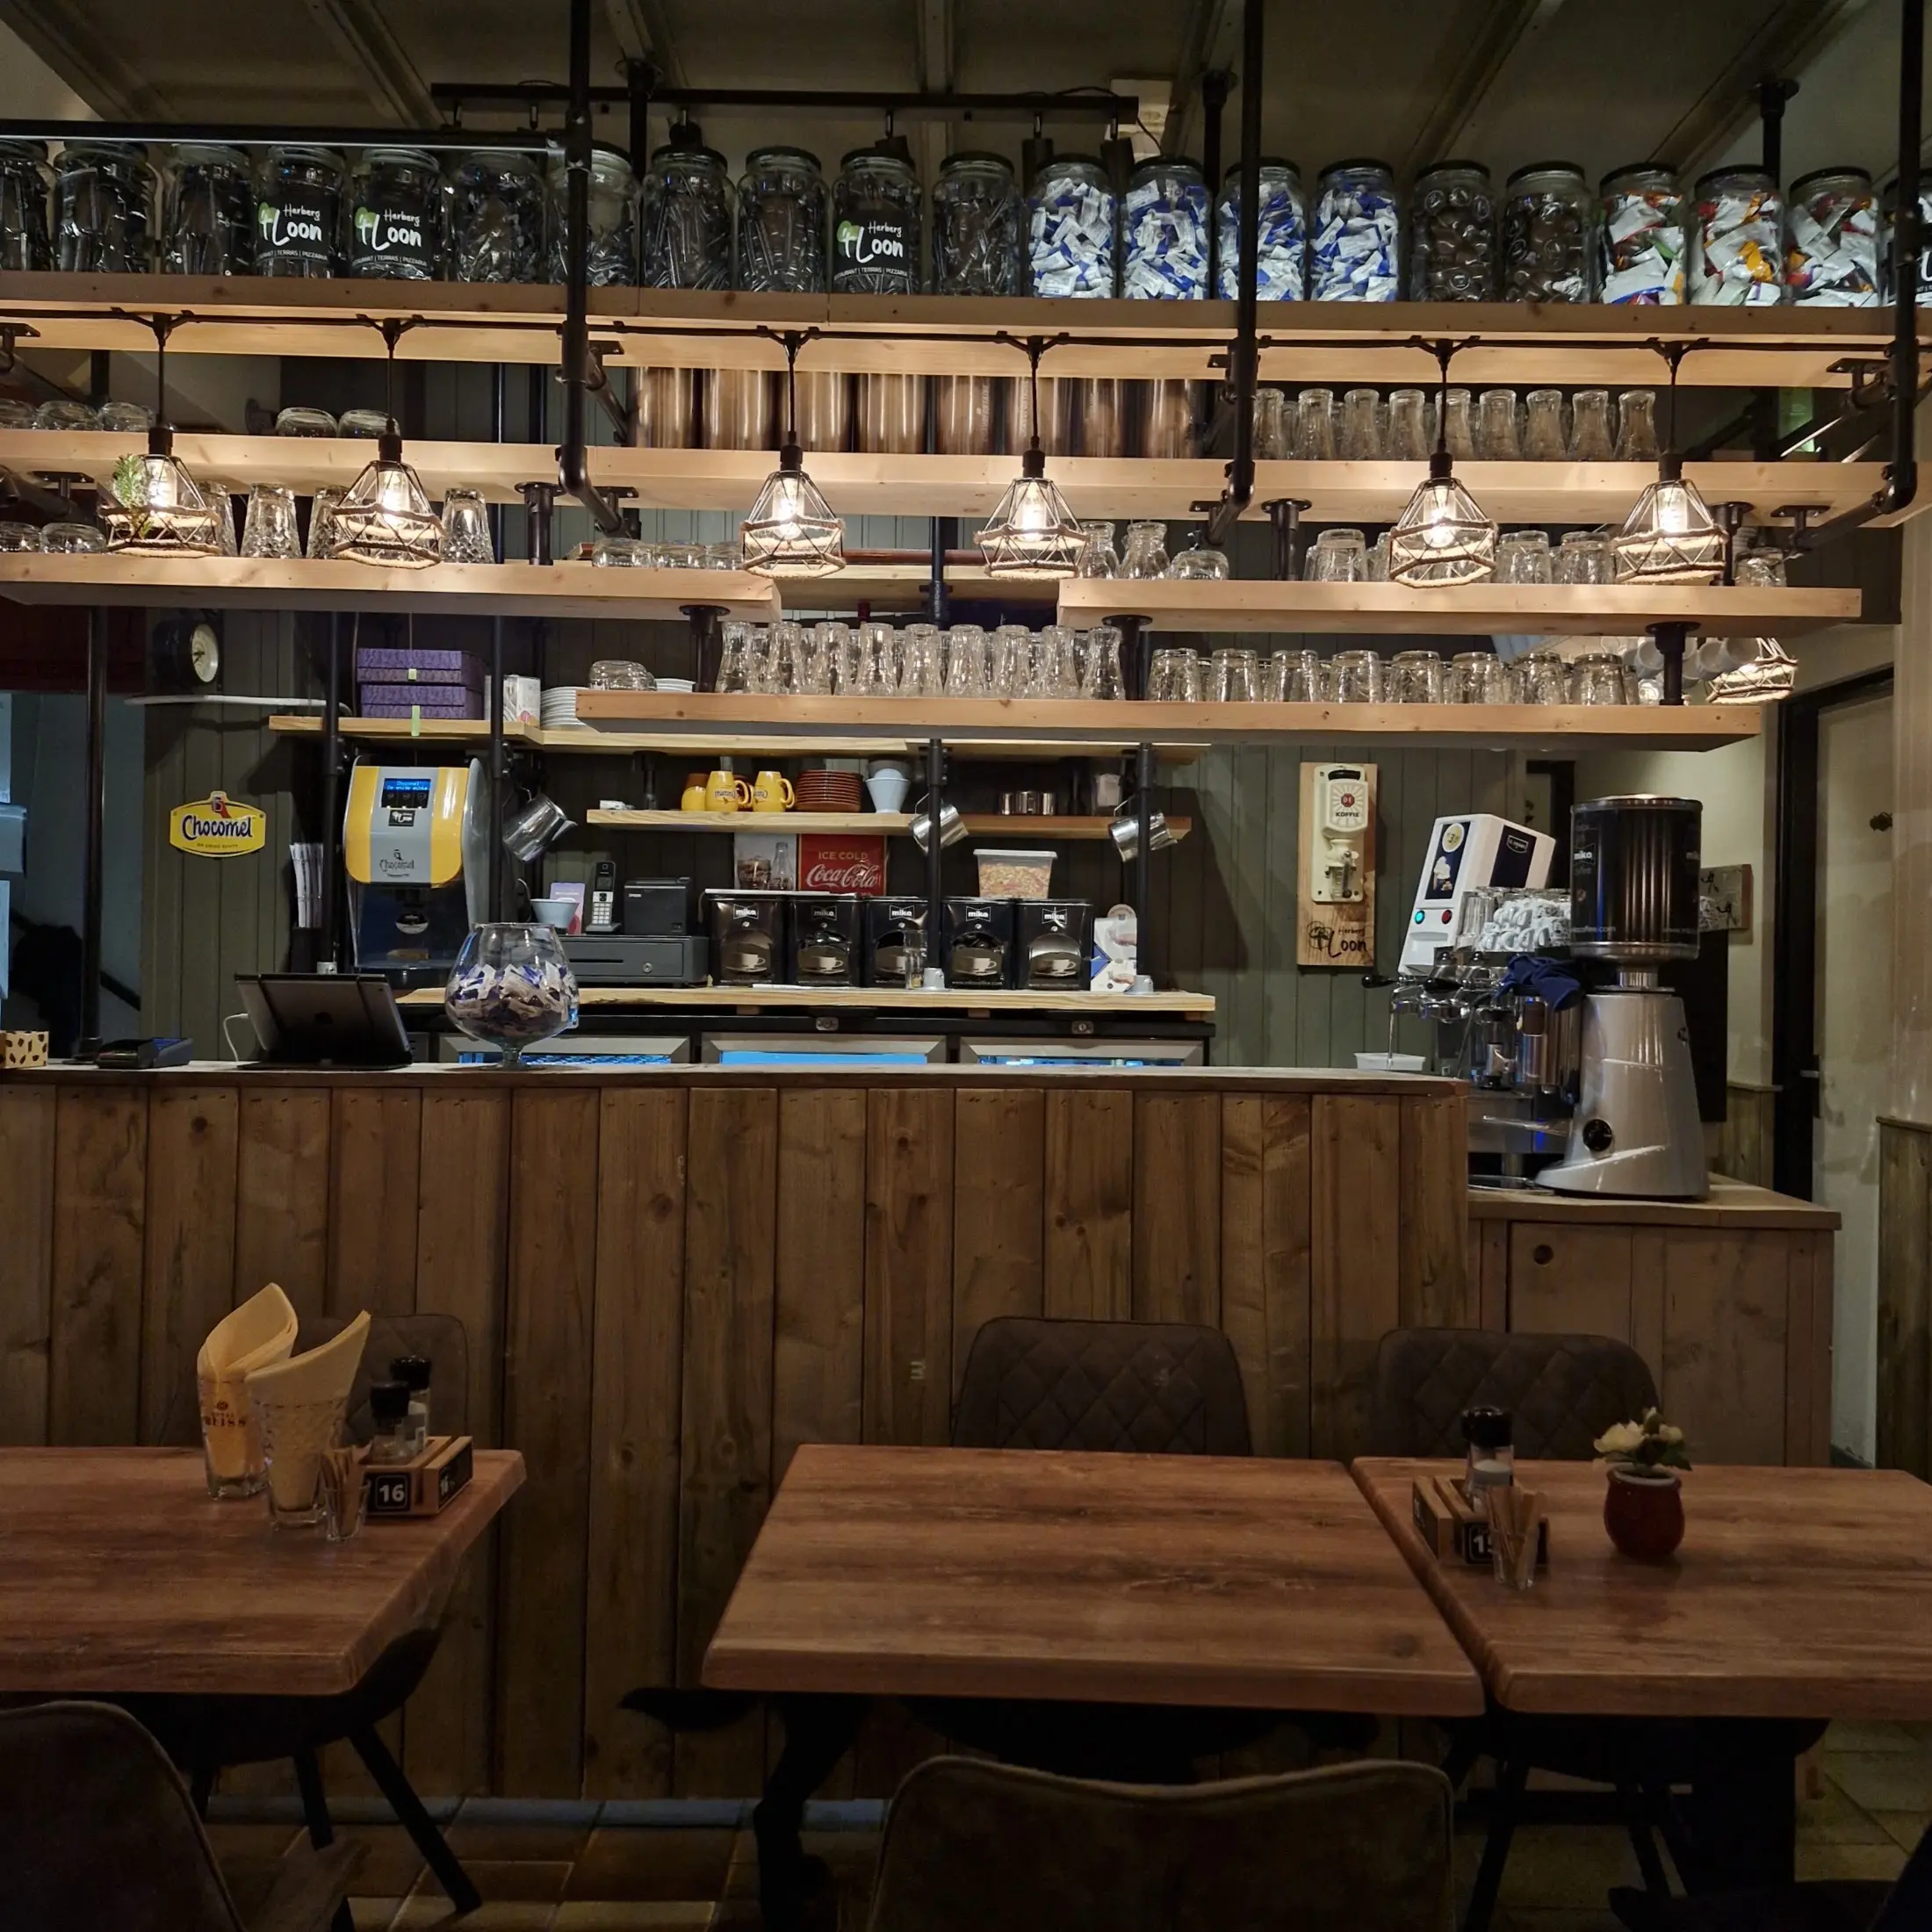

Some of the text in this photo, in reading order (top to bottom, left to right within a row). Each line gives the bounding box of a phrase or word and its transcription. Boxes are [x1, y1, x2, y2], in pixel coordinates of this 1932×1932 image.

[283, 203, 321, 221] Herberg
[384, 208, 420, 227] Herberg
[272, 209, 322, 246] Loon
[371, 213, 422, 251] Loon
[868, 221, 902, 238] Herberg
[855, 226, 903, 263] Loon
[182, 814, 253, 841] Chocomel
[818, 851, 869, 861] ICE COLD
[1328, 930, 1366, 958] Loon
[379, 1484, 405, 1503] 16
